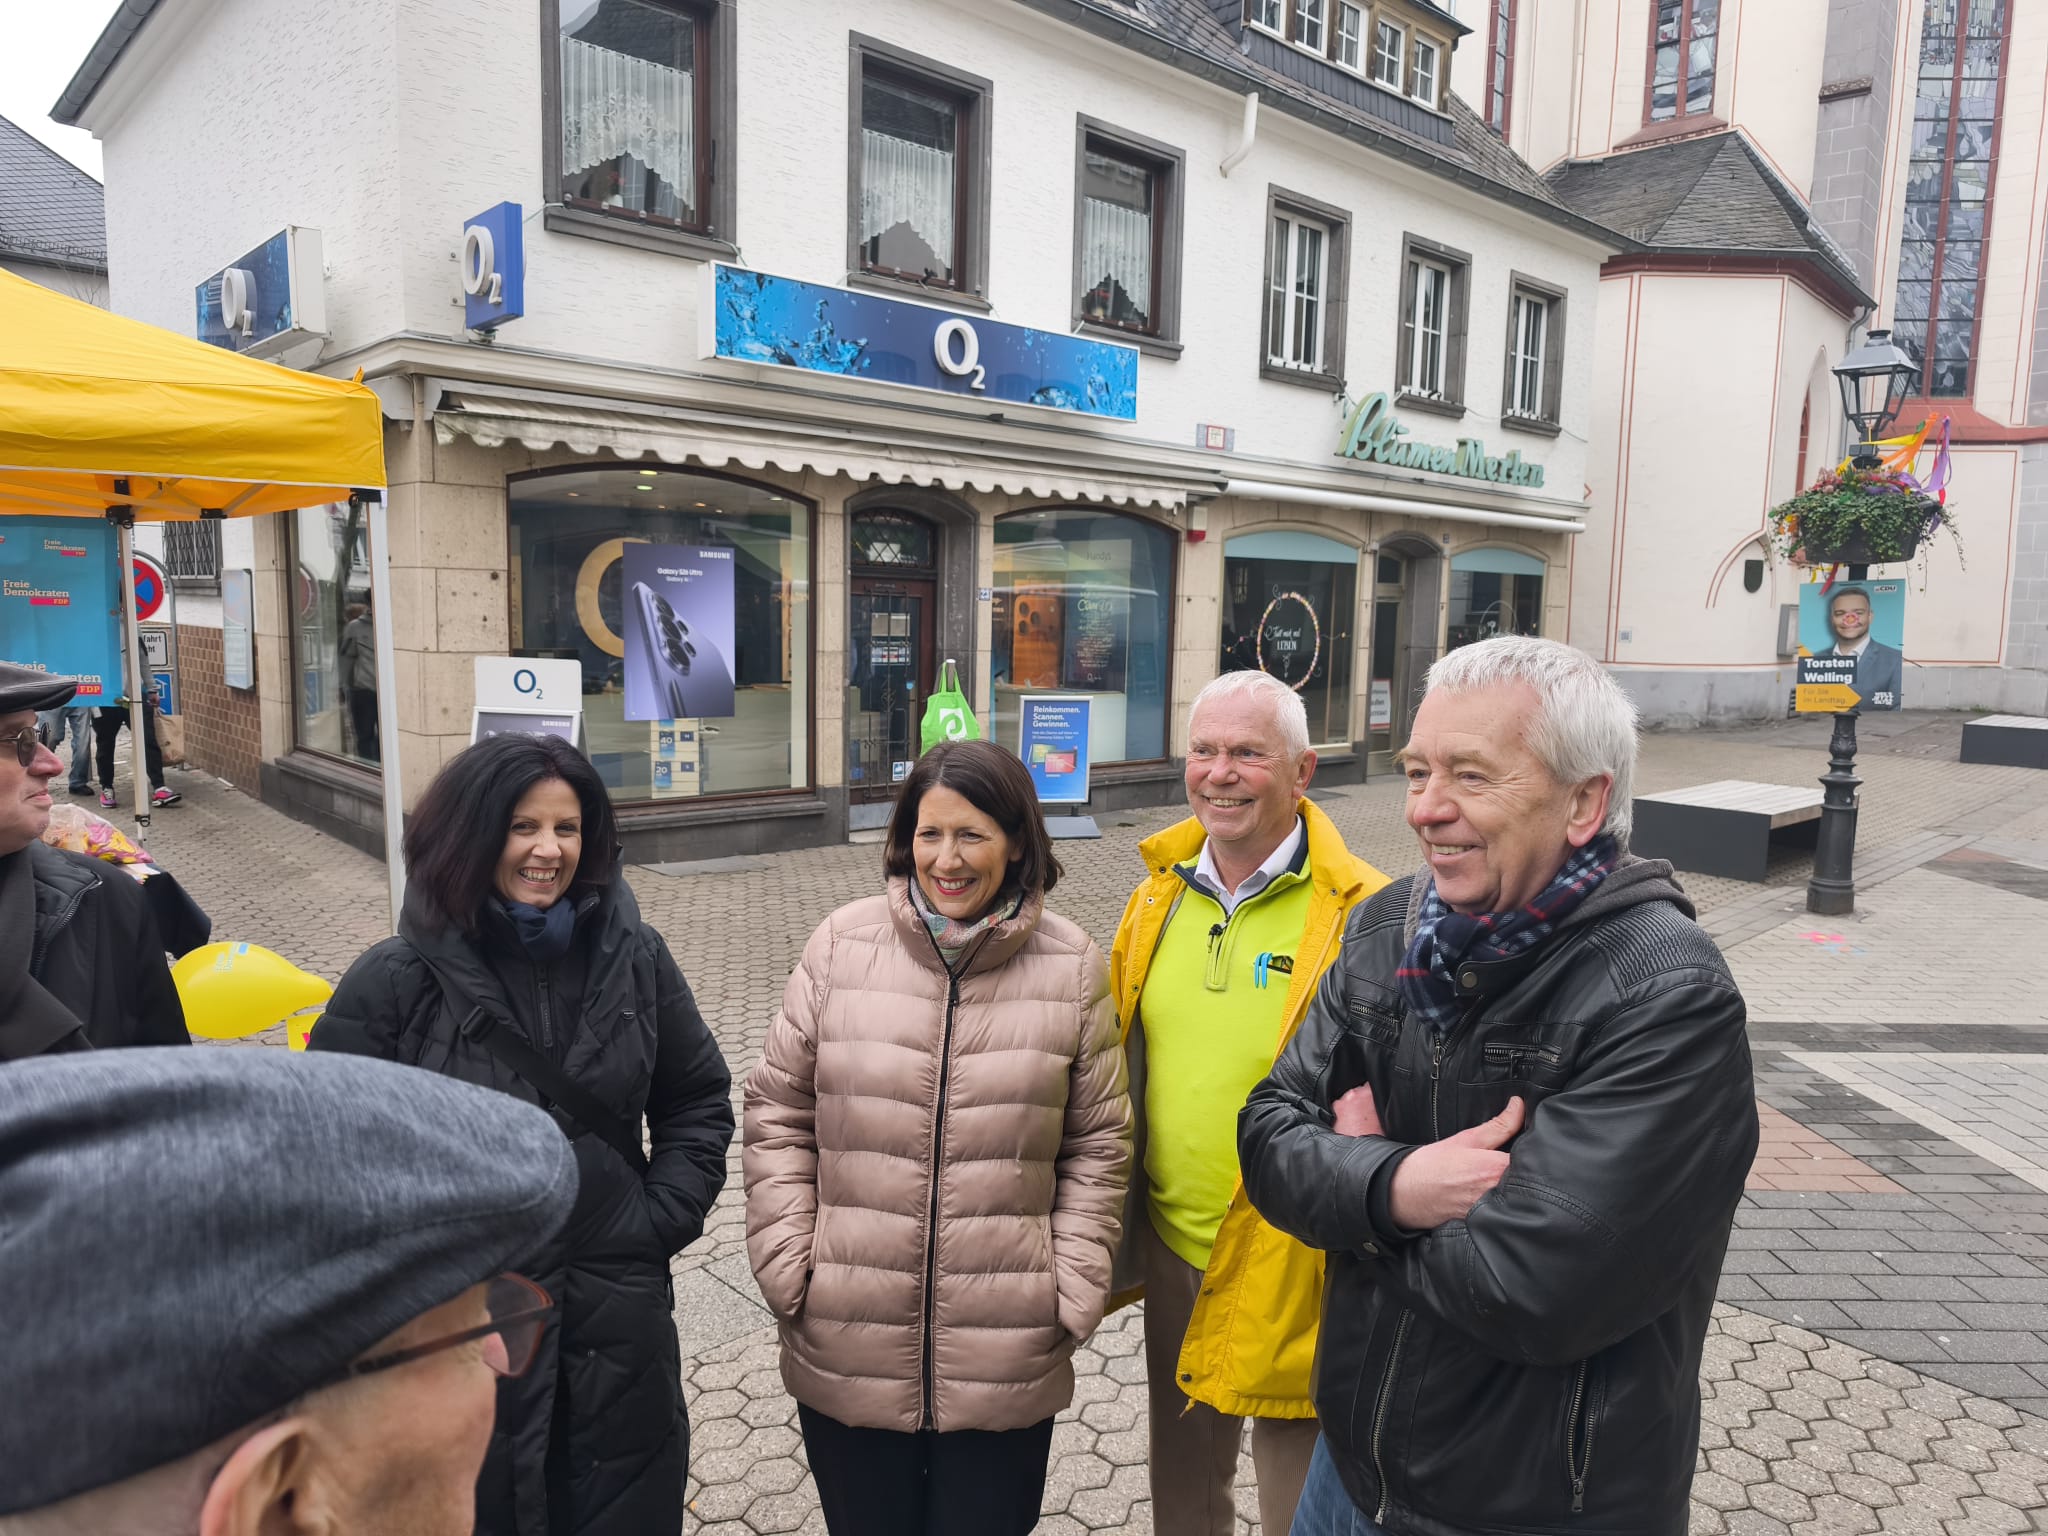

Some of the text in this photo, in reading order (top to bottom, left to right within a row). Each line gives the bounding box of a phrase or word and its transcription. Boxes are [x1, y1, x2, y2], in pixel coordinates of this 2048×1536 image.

[934, 318, 986, 390] O2
[1335, 391, 1457, 475] Blumen
[699, 551, 731, 559] SAMSUNG
[3, 580, 30, 588] Freie
[3, 588, 69, 597] Demokraten
[143, 633, 162, 643] fahrt
[1804, 658, 1854, 668] Torsten
[1804, 672, 1853, 684] Welling
[80, 685, 100, 693] FDP
[513, 669, 544, 700] O2
[1033, 720, 1071, 728] Gewinnen.
[655, 766, 668, 774] 20
